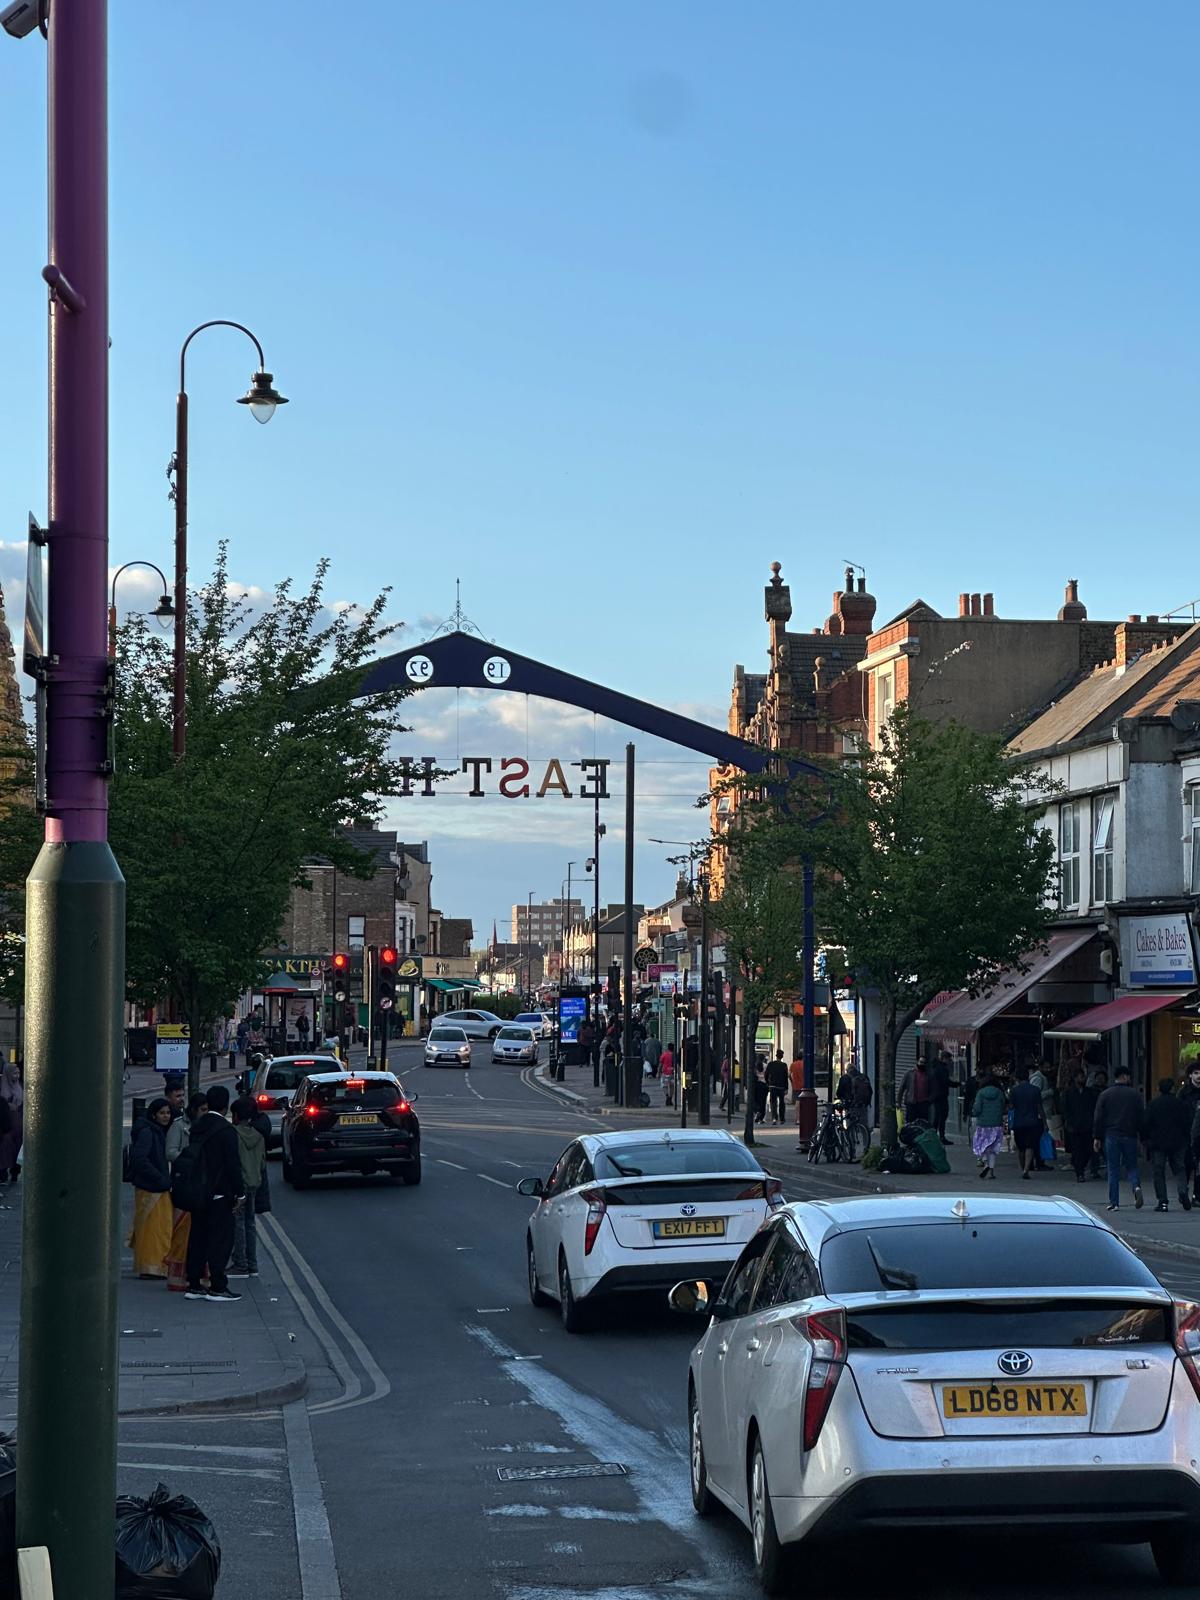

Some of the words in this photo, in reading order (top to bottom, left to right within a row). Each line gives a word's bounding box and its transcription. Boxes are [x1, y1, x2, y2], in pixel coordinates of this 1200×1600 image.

[1136, 928, 1157, 953] Cakes
[1157, 928, 1164, 952] &
[1165, 926, 1187, 951] Bakes
[664, 1222, 692, 1235] EX17
[695, 1221, 719, 1233] FFT
[951, 1388, 1018, 1413] LD68
[1027, 1386, 1076, 1412] NTX
